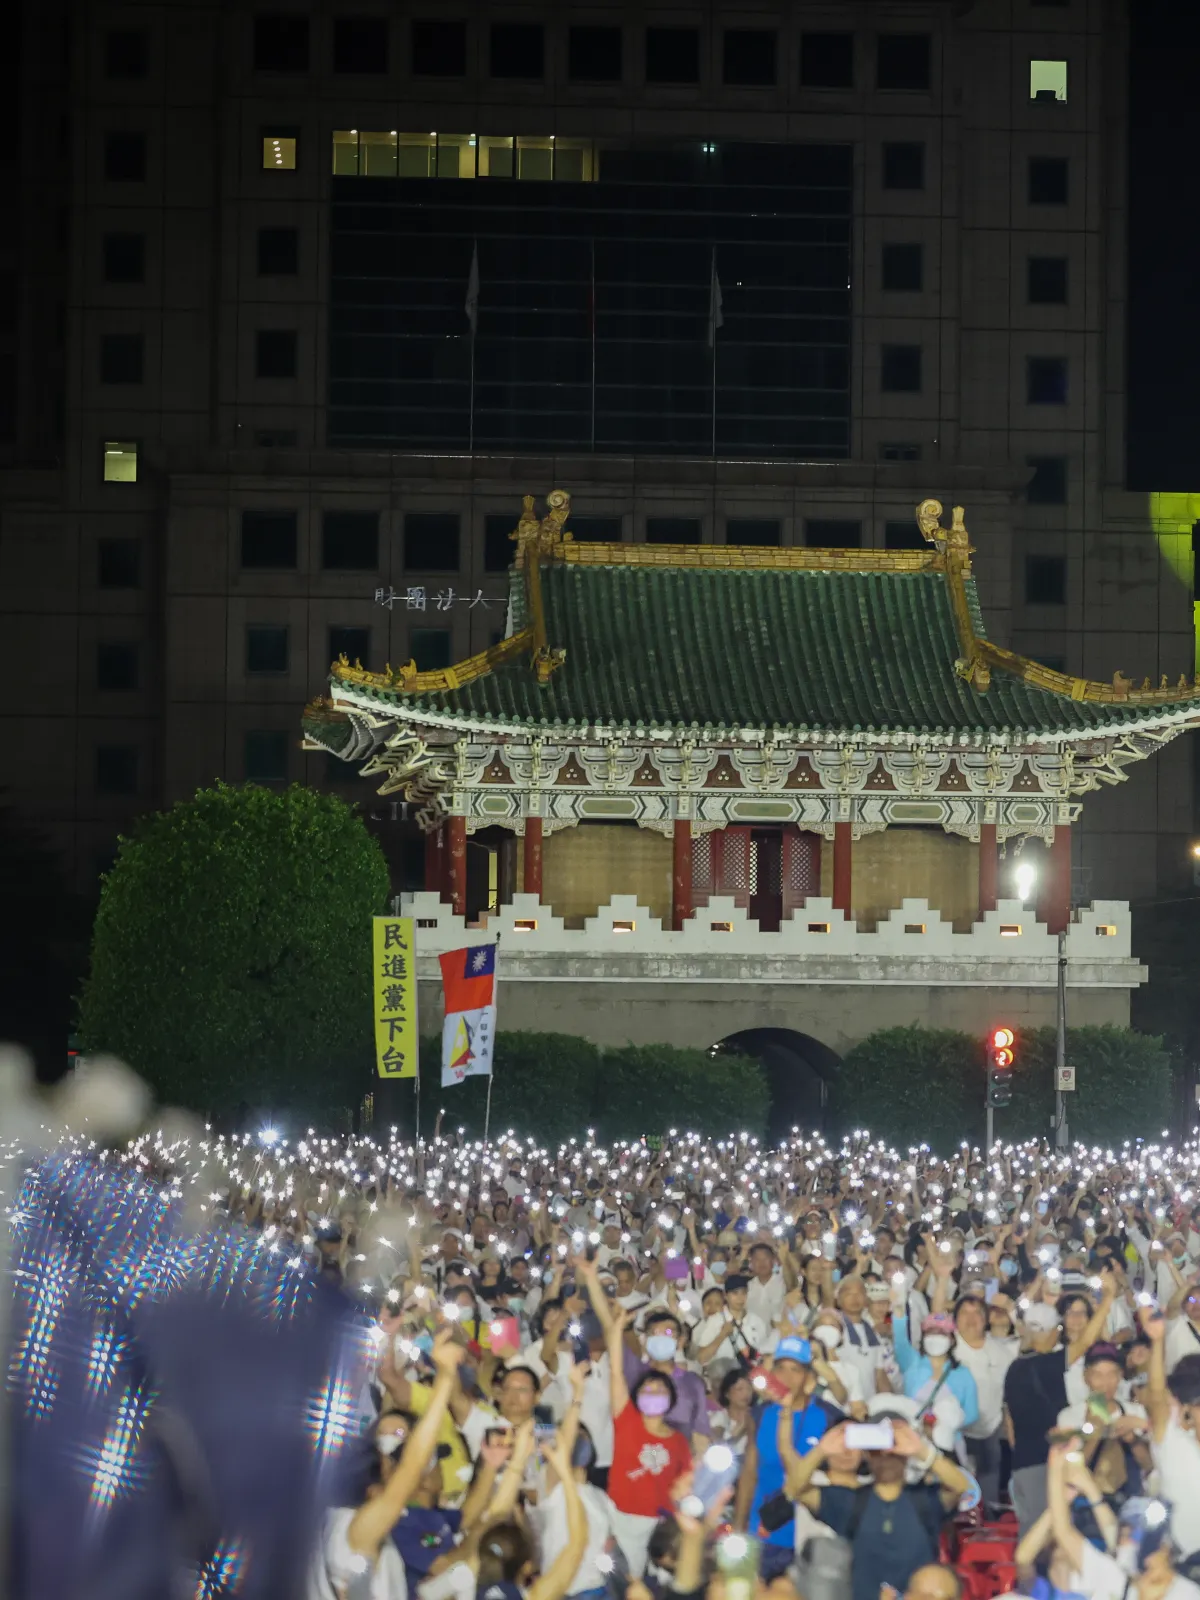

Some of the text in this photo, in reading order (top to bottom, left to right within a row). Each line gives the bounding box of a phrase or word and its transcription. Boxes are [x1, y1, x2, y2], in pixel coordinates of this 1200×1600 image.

[373, 586, 492, 611] 財團法人
[380, 923, 408, 1074] 民進黨下台
